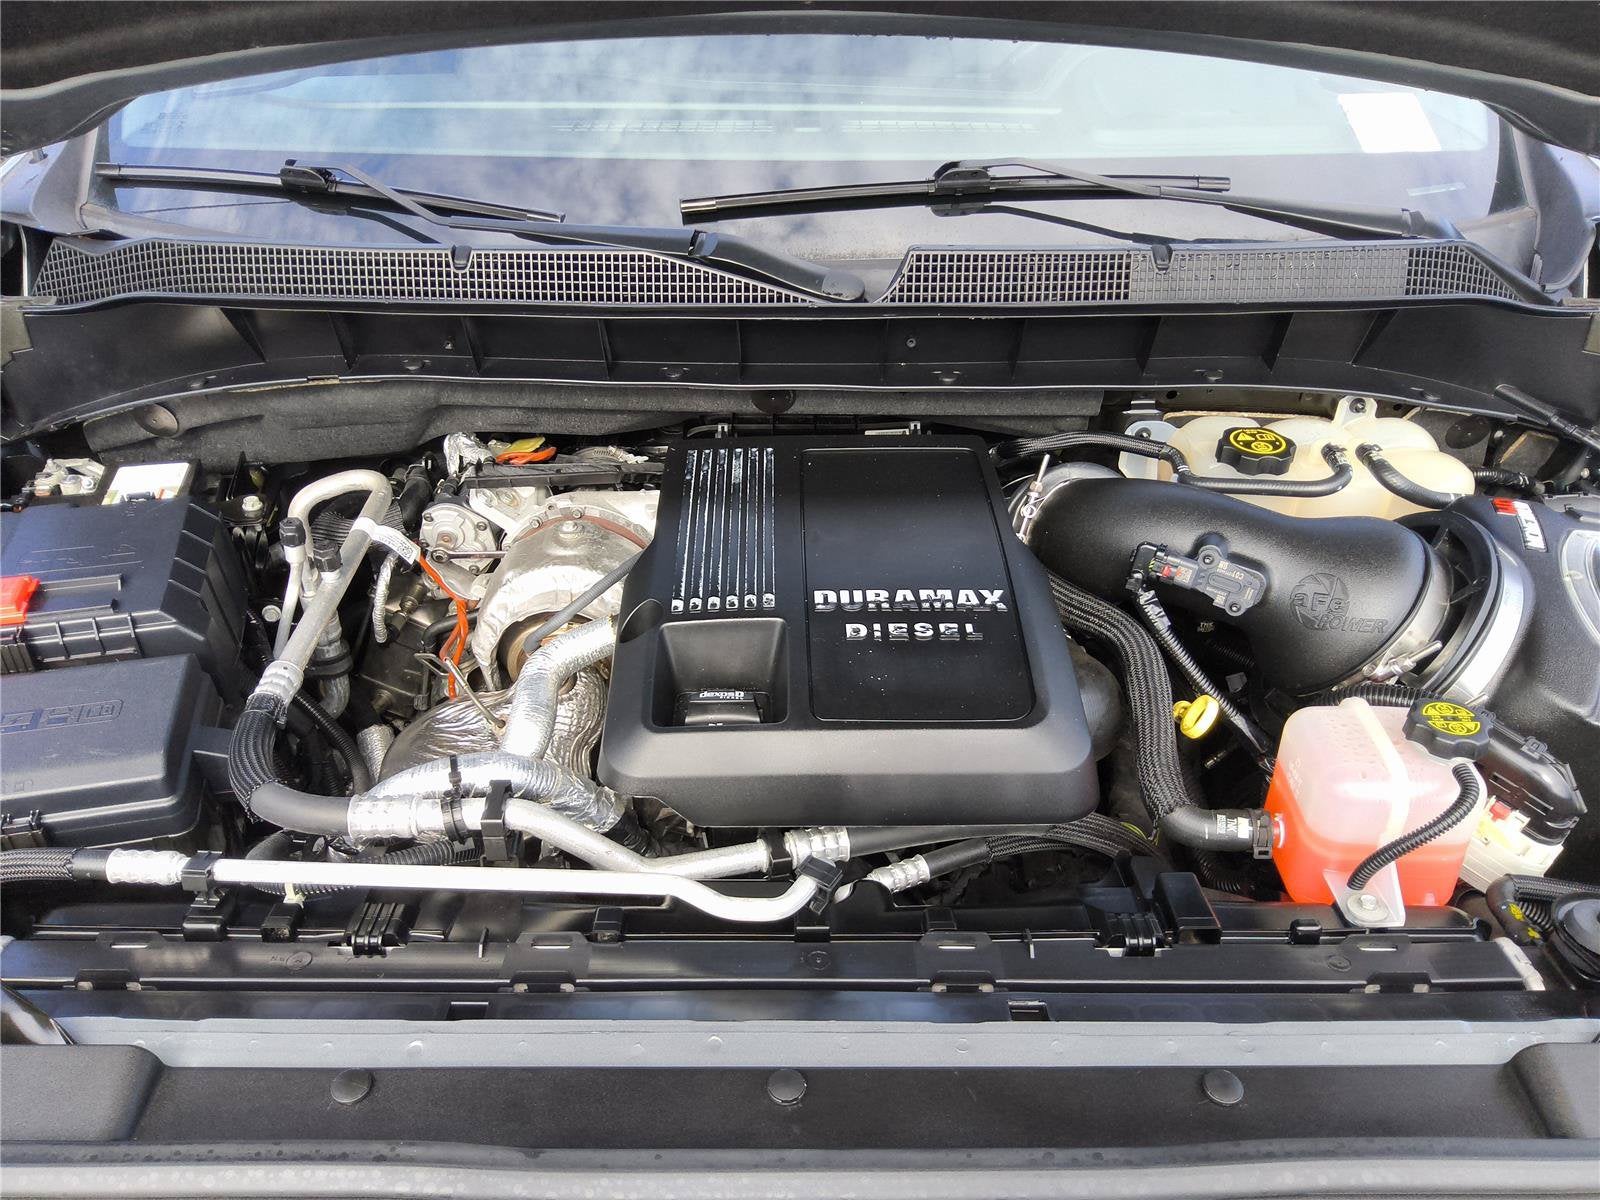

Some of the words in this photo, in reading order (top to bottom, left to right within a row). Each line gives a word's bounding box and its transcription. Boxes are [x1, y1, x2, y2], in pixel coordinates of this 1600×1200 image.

[813, 589, 1008, 612] DURAMAX
[845, 622, 984, 641] DIESEL
[1318, 614, 1388, 634] POWER
